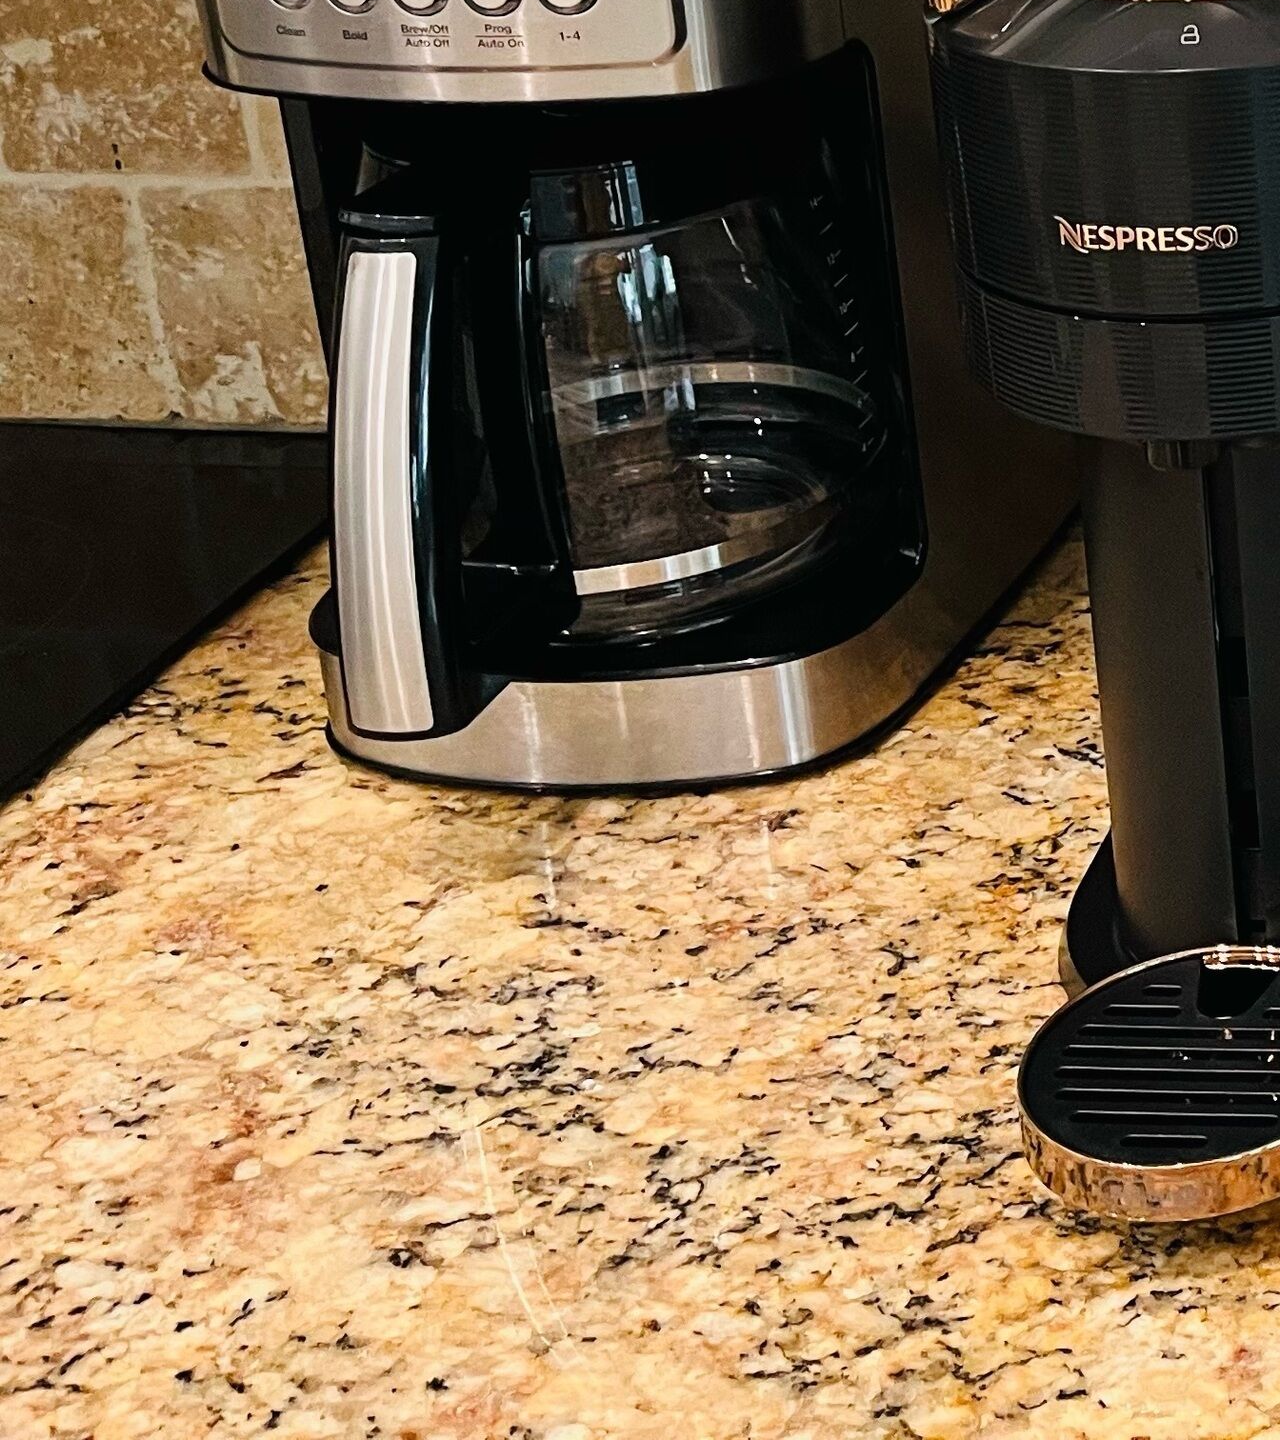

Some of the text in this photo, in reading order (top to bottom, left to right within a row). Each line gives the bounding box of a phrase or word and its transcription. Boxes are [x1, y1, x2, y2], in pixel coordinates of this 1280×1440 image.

[484, 24, 513, 35] Prog
[559, 30, 581, 42] 1-4
[405, 39, 450, 48] Auto Off
[477, 39, 525, 49] Auto On
[1053, 215, 1238, 254] NESPRESSO
